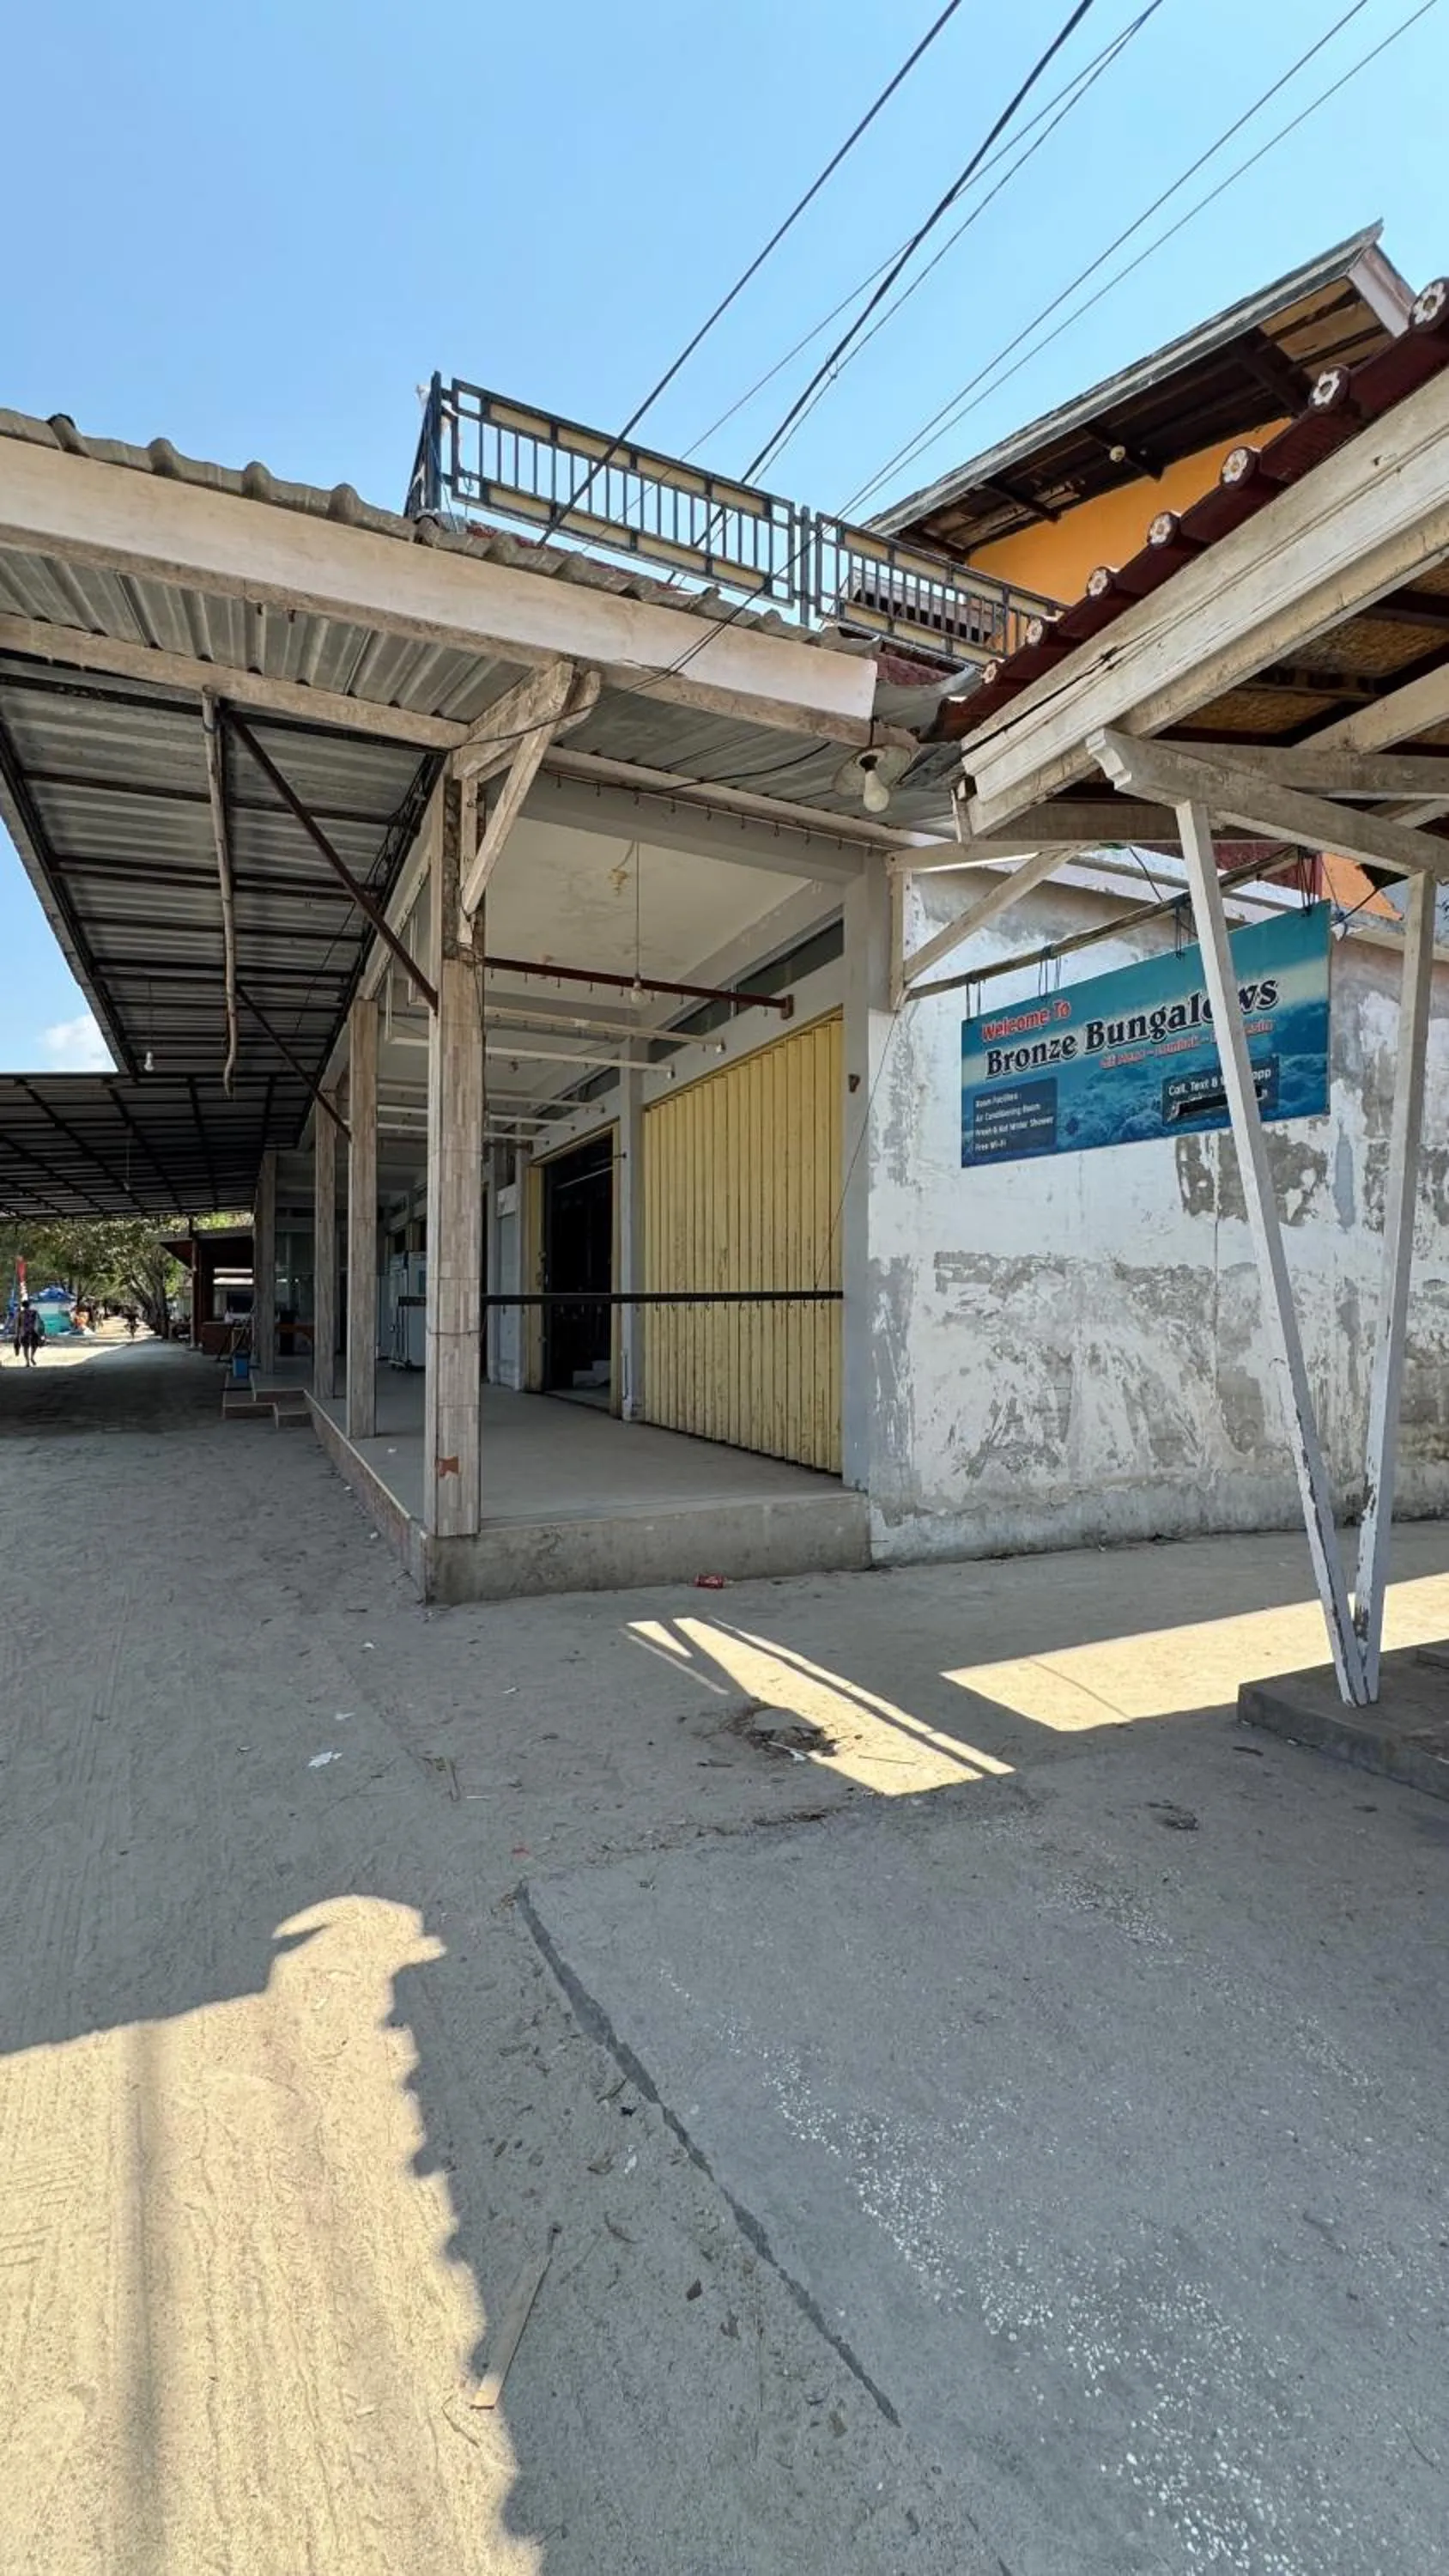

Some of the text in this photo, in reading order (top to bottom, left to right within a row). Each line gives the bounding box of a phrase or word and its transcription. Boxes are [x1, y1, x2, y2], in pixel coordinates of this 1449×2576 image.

[981, 999, 1071, 1042] Welcome To
[985, 1034, 1079, 1078] Bronze
[1030, 1116, 1054, 1127] Shower
